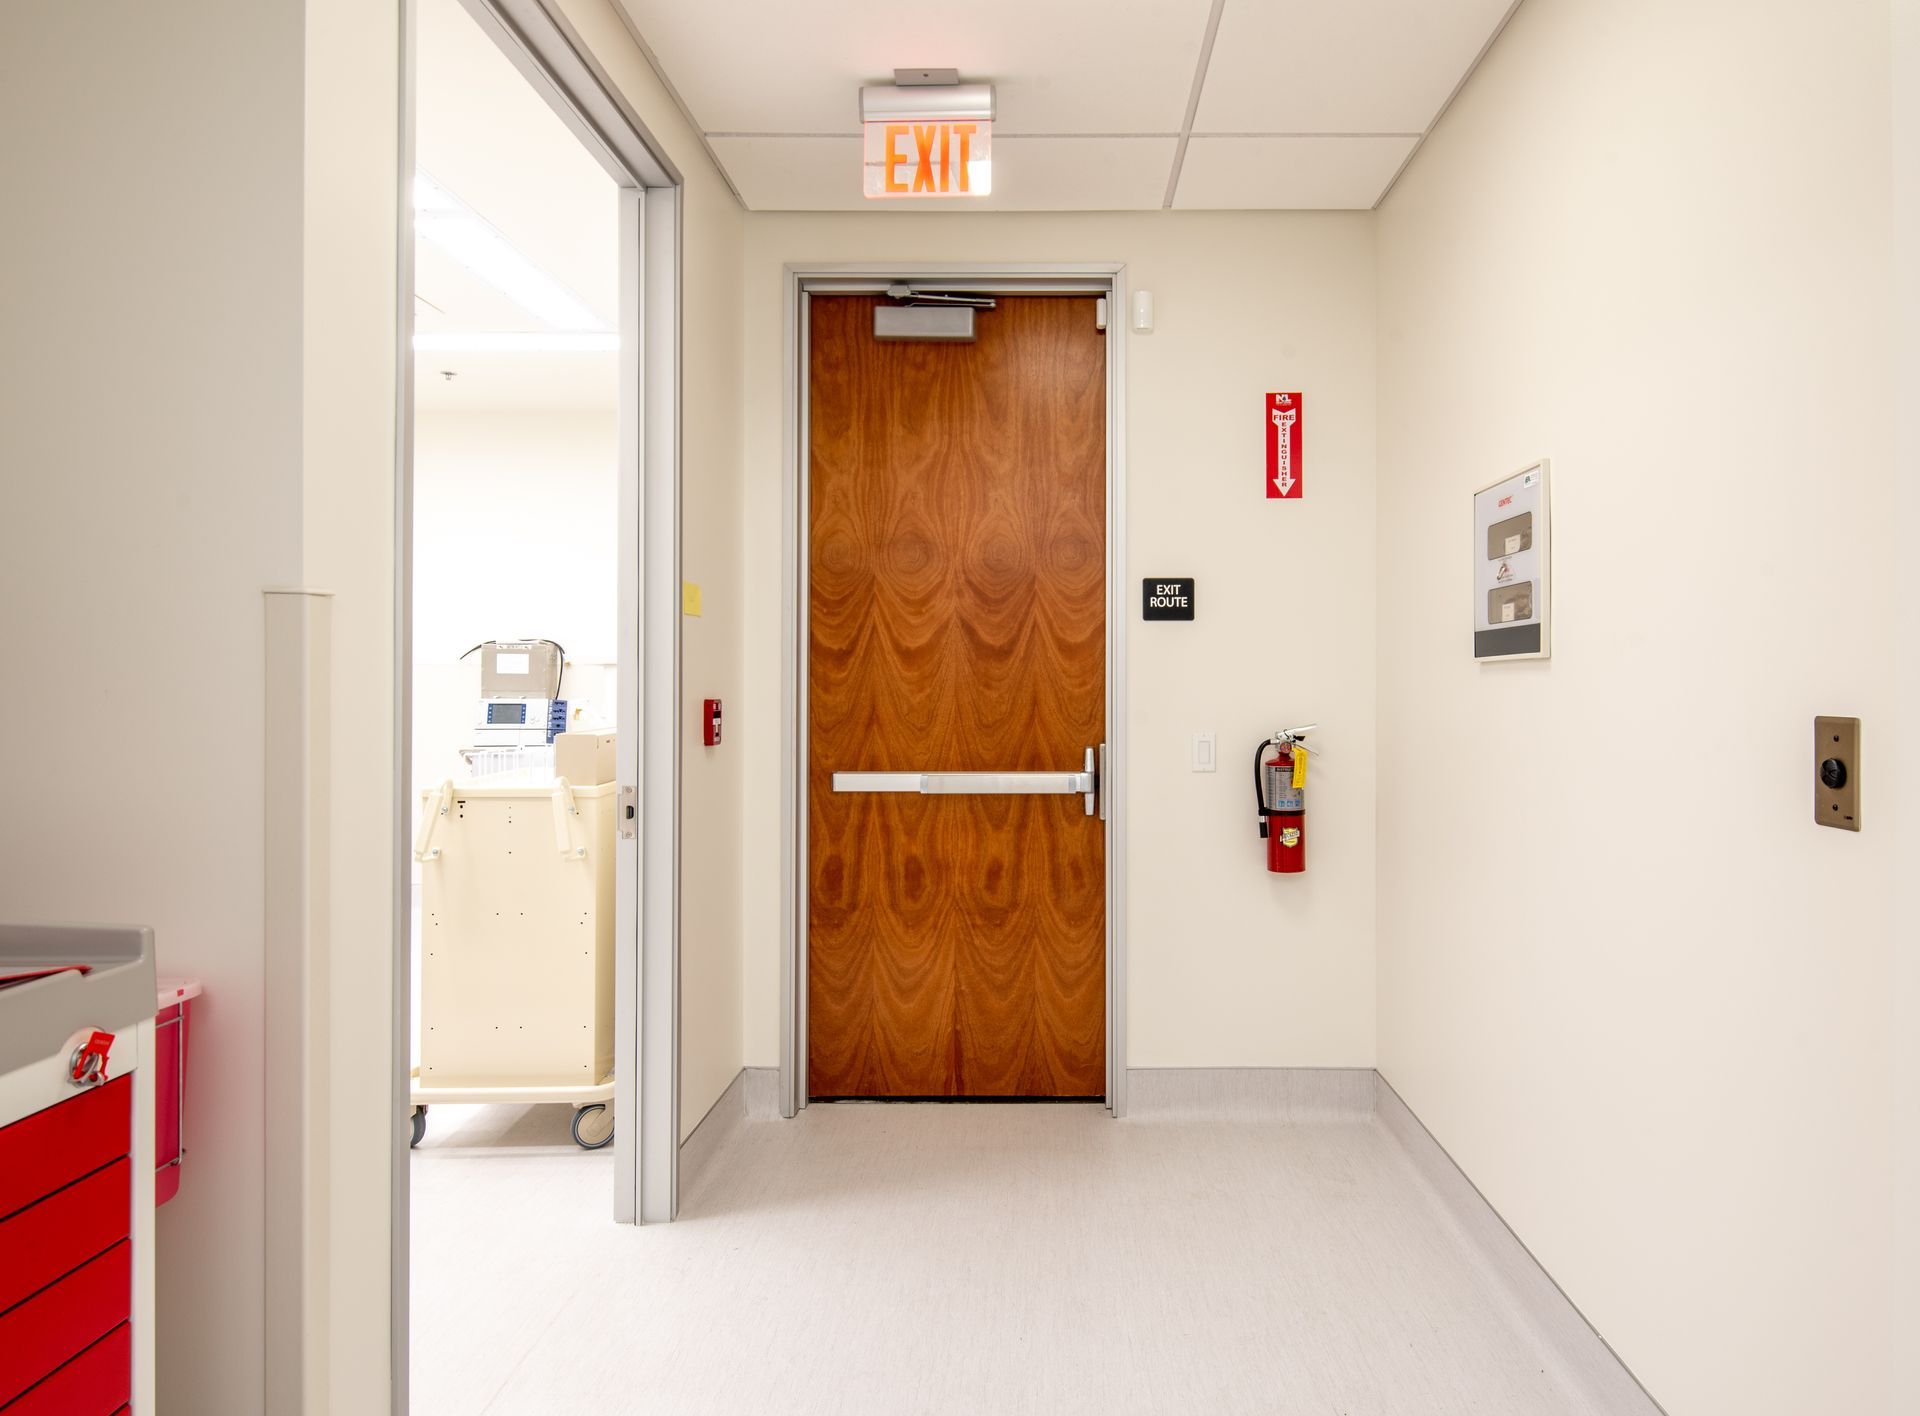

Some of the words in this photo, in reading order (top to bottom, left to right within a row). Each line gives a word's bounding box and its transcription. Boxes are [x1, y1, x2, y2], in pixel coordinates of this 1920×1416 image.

[885, 124, 977, 193] EXIT
[1156, 584, 1181, 595] EXIT
[1150, 596, 1188, 607] ROUTE
